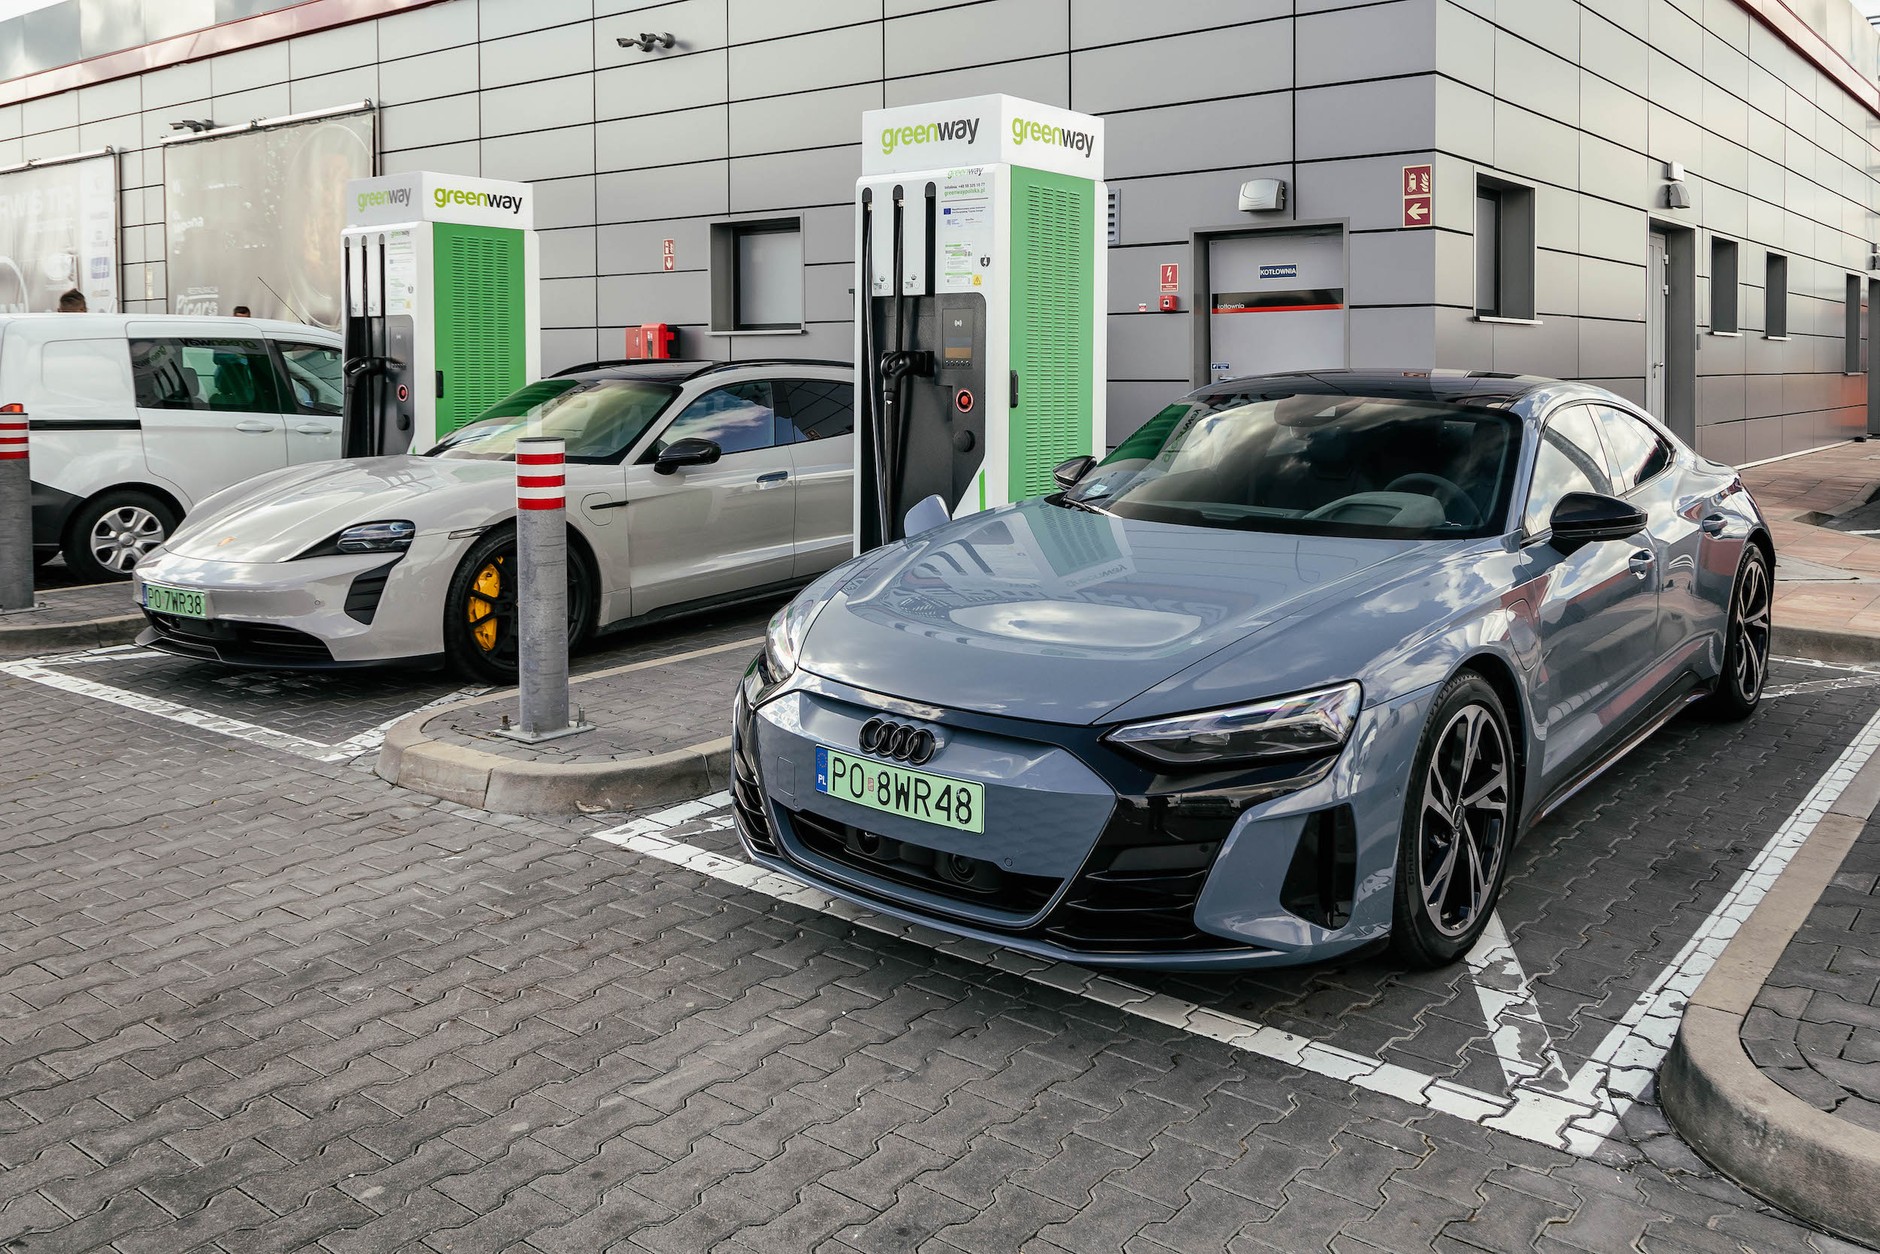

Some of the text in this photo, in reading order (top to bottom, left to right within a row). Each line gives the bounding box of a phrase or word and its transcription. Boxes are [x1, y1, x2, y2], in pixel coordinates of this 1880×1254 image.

[881, 117, 980, 155] greenway
[1012, 117, 1095, 158] greenway
[947, 167, 984, 180] greenway
[357, 187, 412, 213] greenway
[434, 187, 523, 215] greenway
[1260, 267, 1297, 276] KOTŁOWNIA
[148, 587, 202, 615] PO 7WR38
[817, 774, 826, 786] PL
[831, 756, 972, 825] PO 8WR48
